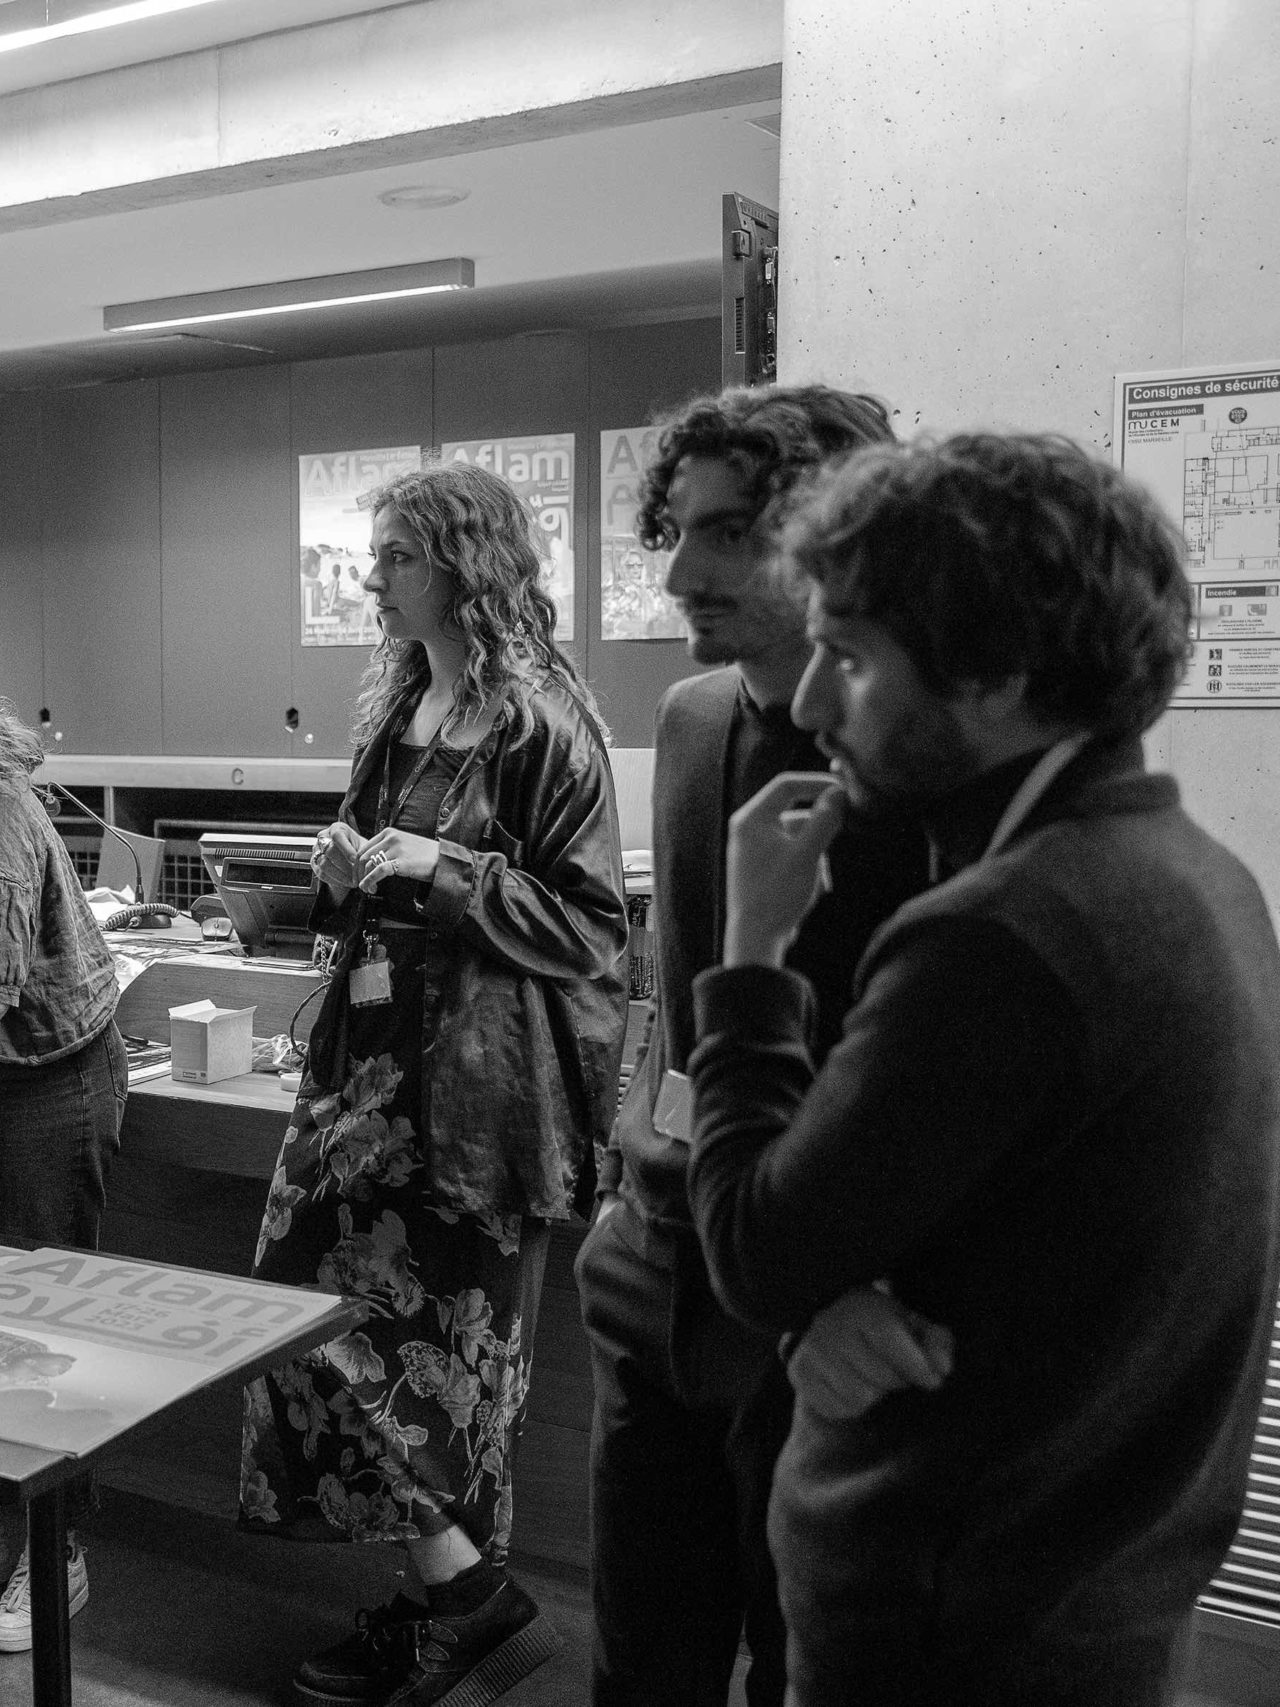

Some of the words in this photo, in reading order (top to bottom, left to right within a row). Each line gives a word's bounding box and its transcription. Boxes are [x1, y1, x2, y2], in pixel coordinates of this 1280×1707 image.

[1133, 385, 1201, 399] Consignes
[1205, 381, 1221, 393] de
[1224, 376, 1279, 392] sécurité
[1131, 409, 1148, 418] Plan
[1149, 407, 1197, 417] d'évacuation
[1207, 589, 1237, 597] Incendie
[7, 1257, 305, 1323] Aflam
